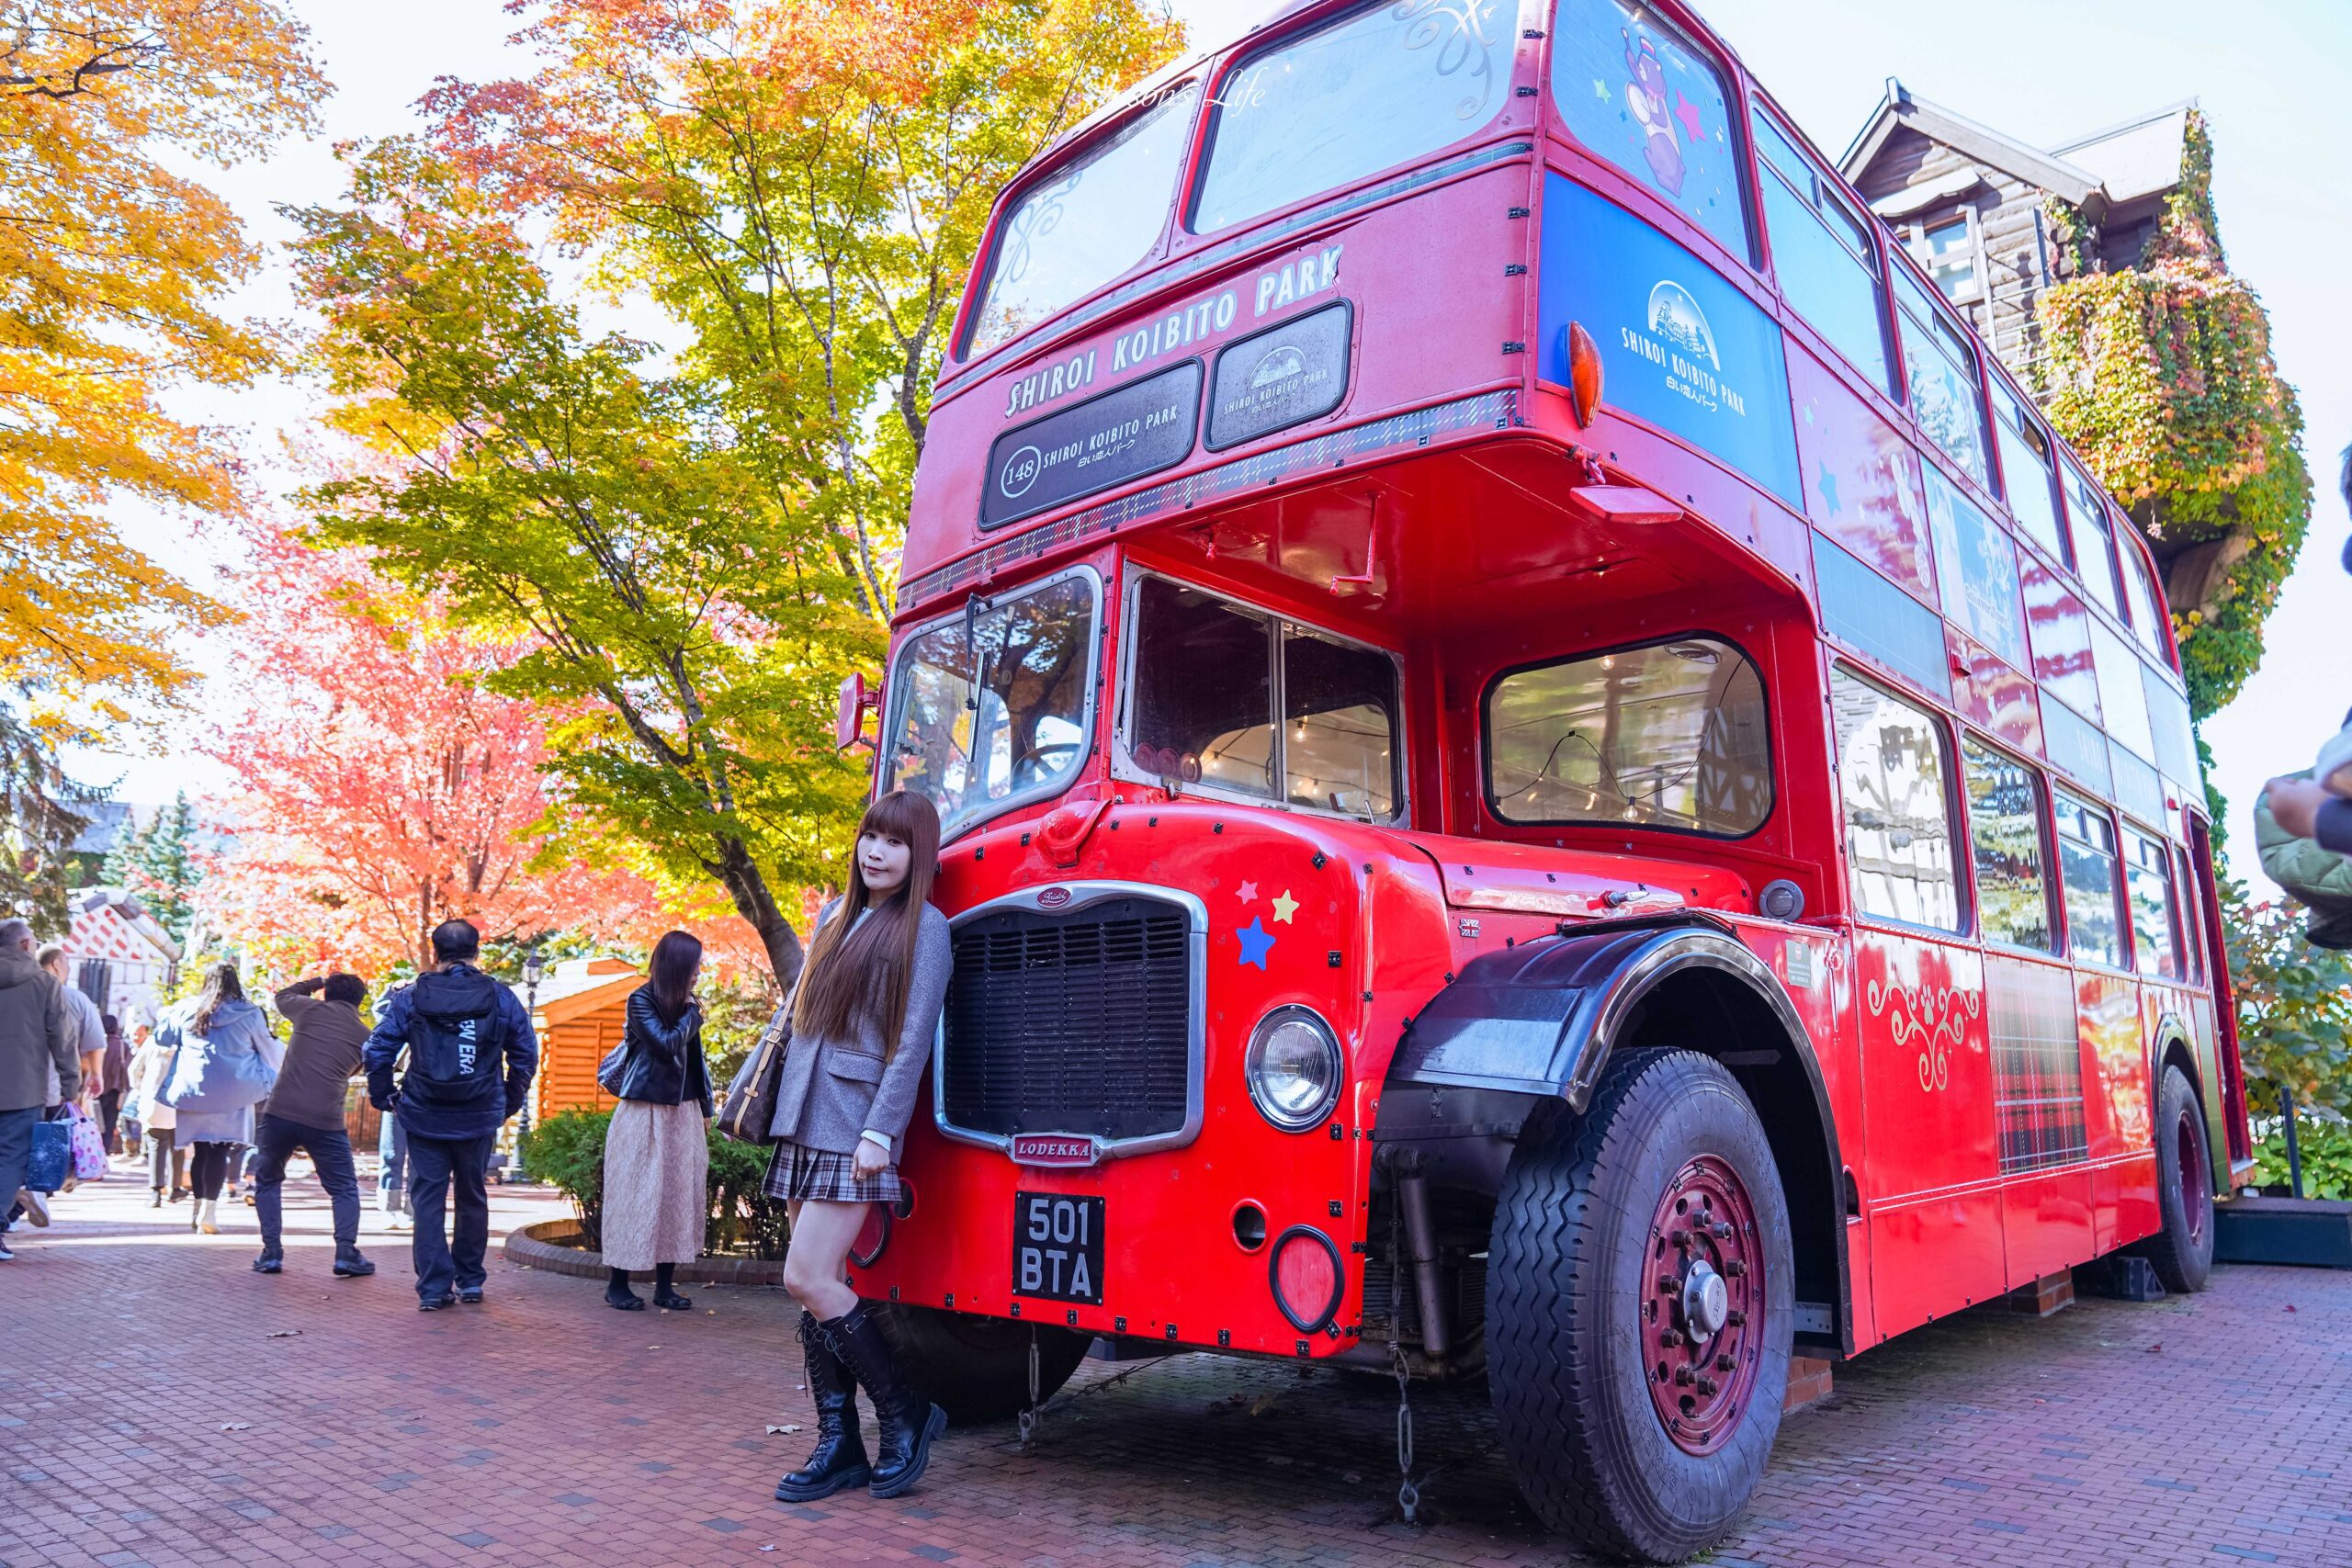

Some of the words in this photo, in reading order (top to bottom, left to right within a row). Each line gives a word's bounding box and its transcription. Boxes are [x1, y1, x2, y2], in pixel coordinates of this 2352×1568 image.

[1005, 351, 1095, 417] SHIROI
[1114, 293, 1234, 371] KOIBITO
[1258, 246, 1342, 312] PARK
[1224, 395, 1254, 414] SHIROI
[1260, 379, 1298, 401] KOIBITO
[1304, 368, 1328, 385] PARK
[1622, 327, 1666, 367] SHIROI
[1672, 354, 1716, 397] KOIBITO
[1721, 384, 1745, 416] PARK
[1667, 376, 1717, 412] 白い恋人パーク
[1007, 459, 1035, 485] 148
[1044, 441, 1083, 468] SHIROI
[1090, 420, 1139, 451] KOIBITO
[1146, 405, 1177, 429] PARK
[458, 1019, 476, 1041] EW
[458, 1043, 476, 1075] ERA
[1018, 1142, 1091, 1156] LODEKKA
[1029, 1198, 1089, 1246] 501
[1021, 1247, 1091, 1297] BTA
